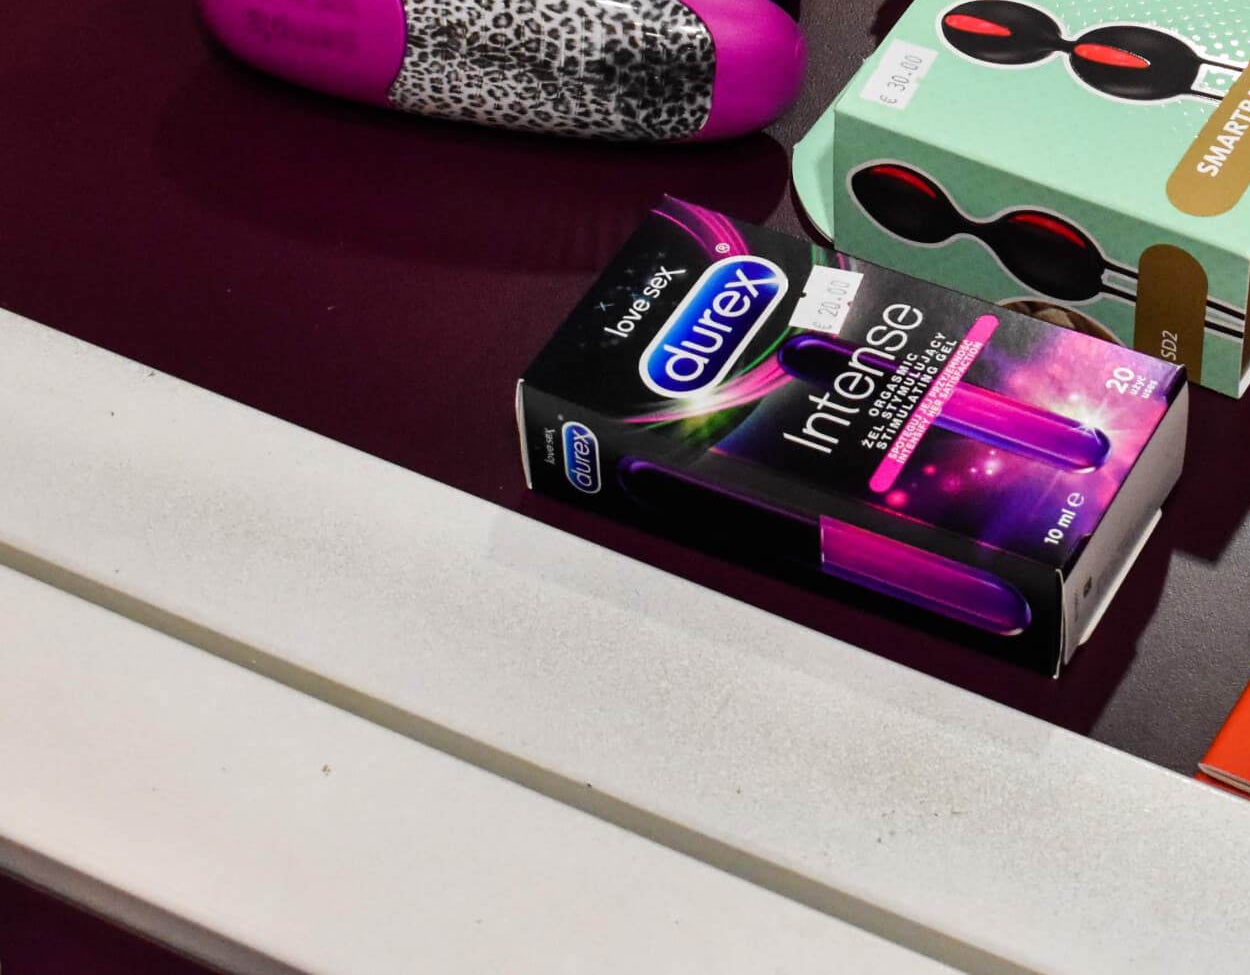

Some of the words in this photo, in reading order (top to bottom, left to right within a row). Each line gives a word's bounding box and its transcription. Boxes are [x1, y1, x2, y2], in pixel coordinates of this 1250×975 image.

[887, 54, 923, 92] 30.00
[604, 295, 652, 338] love
[642, 265, 686, 300] sex
[817, 279, 850, 316] 20.00
[663, 267, 777, 385] durex
[1160, 330, 1180, 361] SD2
[782, 298, 925, 454] Intense
[867, 350, 918, 418] ORGASMIC
[875, 364, 939, 451] STIMULATING
[935, 338, 957, 362] GEL
[896, 417, 931, 464] INTENSIFY
[927, 399, 944, 418] HER
[939, 341, 983, 399] SATISFACTION
[1105, 364, 1136, 395] 20
[1141, 379, 1159, 399] uses
[571, 430, 592, 486] durex
[1043, 526, 1065, 545] 10
[1055, 507, 1077, 528] ml
